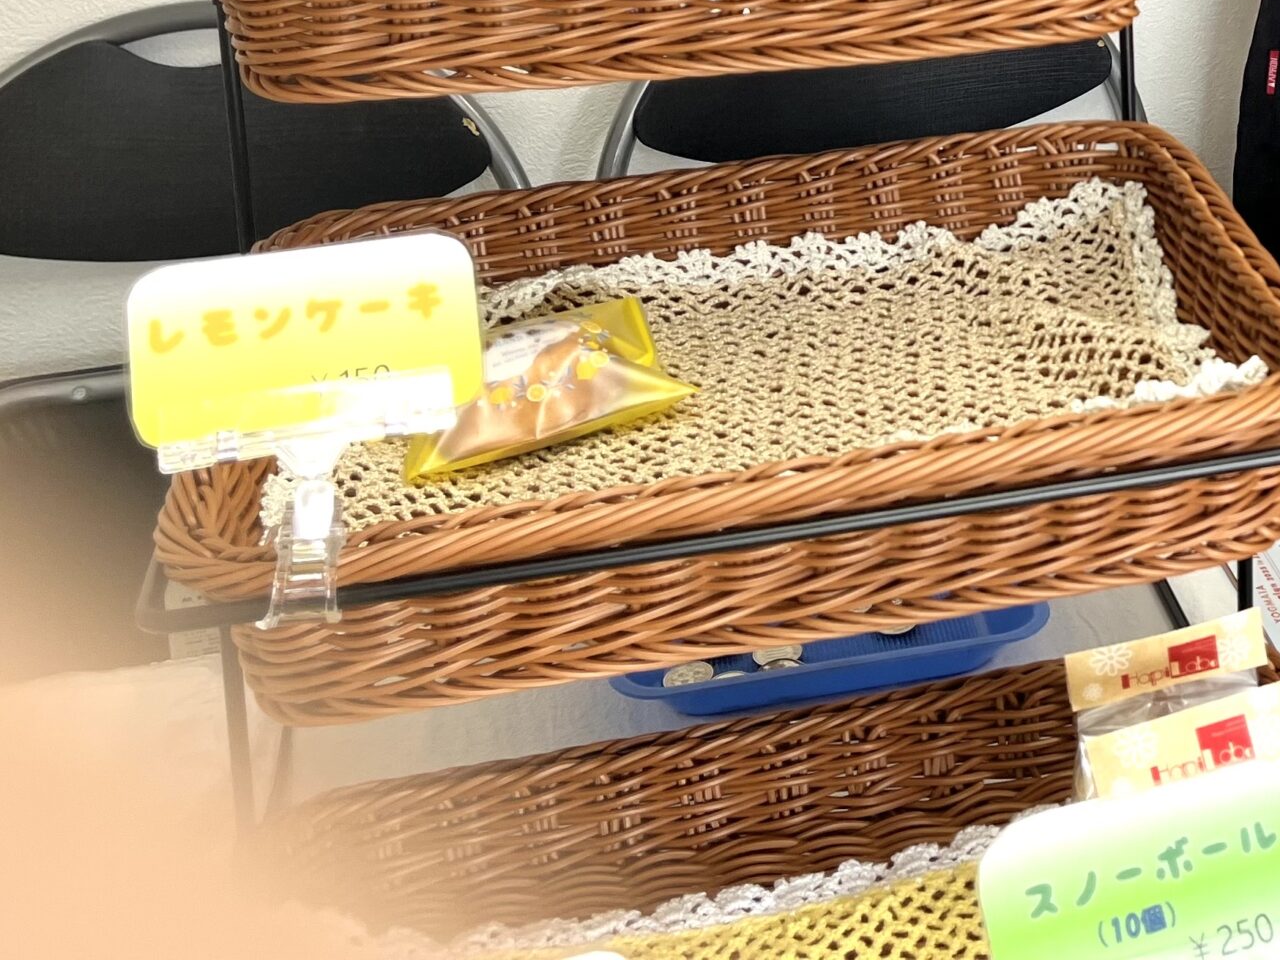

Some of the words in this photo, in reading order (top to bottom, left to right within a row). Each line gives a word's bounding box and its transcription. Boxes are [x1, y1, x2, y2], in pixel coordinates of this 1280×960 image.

[148, 281, 443, 354] レモンケーキ
[1024, 821, 1277, 919] スノーボール
[1097, 901, 1177, 948] (10個)
[1189, 912, 1274, 960] ¥250
